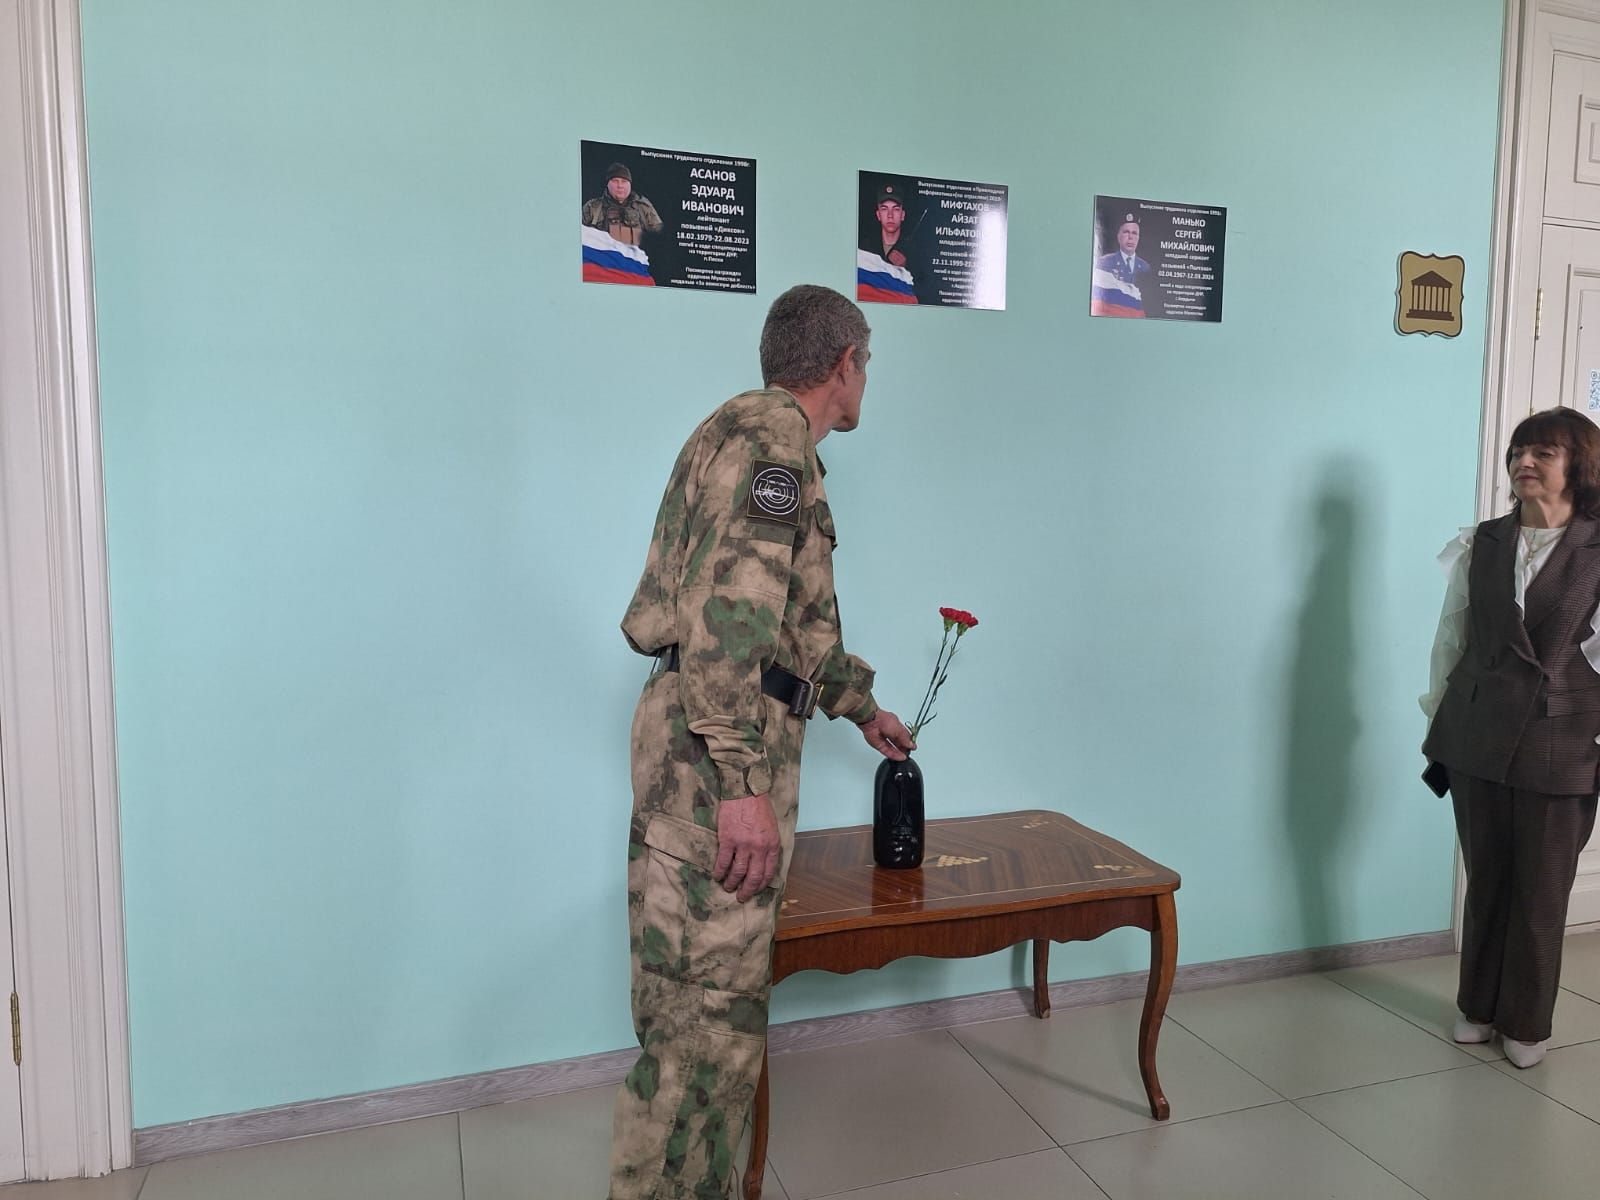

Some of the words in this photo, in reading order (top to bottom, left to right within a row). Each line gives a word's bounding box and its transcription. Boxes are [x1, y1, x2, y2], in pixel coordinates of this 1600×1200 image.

[690, 168, 736, 182] АСАНОВ
[691, 184, 735, 200] ЭДУАРД
[682, 200, 744, 216] ИВАНОВИЧ
[941, 200, 990, 211] МИФТАХОВ
[951, 213, 978, 224] АЙЗАТ
[1172, 217, 1206, 227] МАНЬКО
[681, 223, 713, 231] позывной
[935, 226, 984, 238] ИЛЬФАТО
[1175, 229, 1202, 239] СЕРГЕЙ
[1160, 241, 1215, 253] МИХАЙЛОВИЧ
